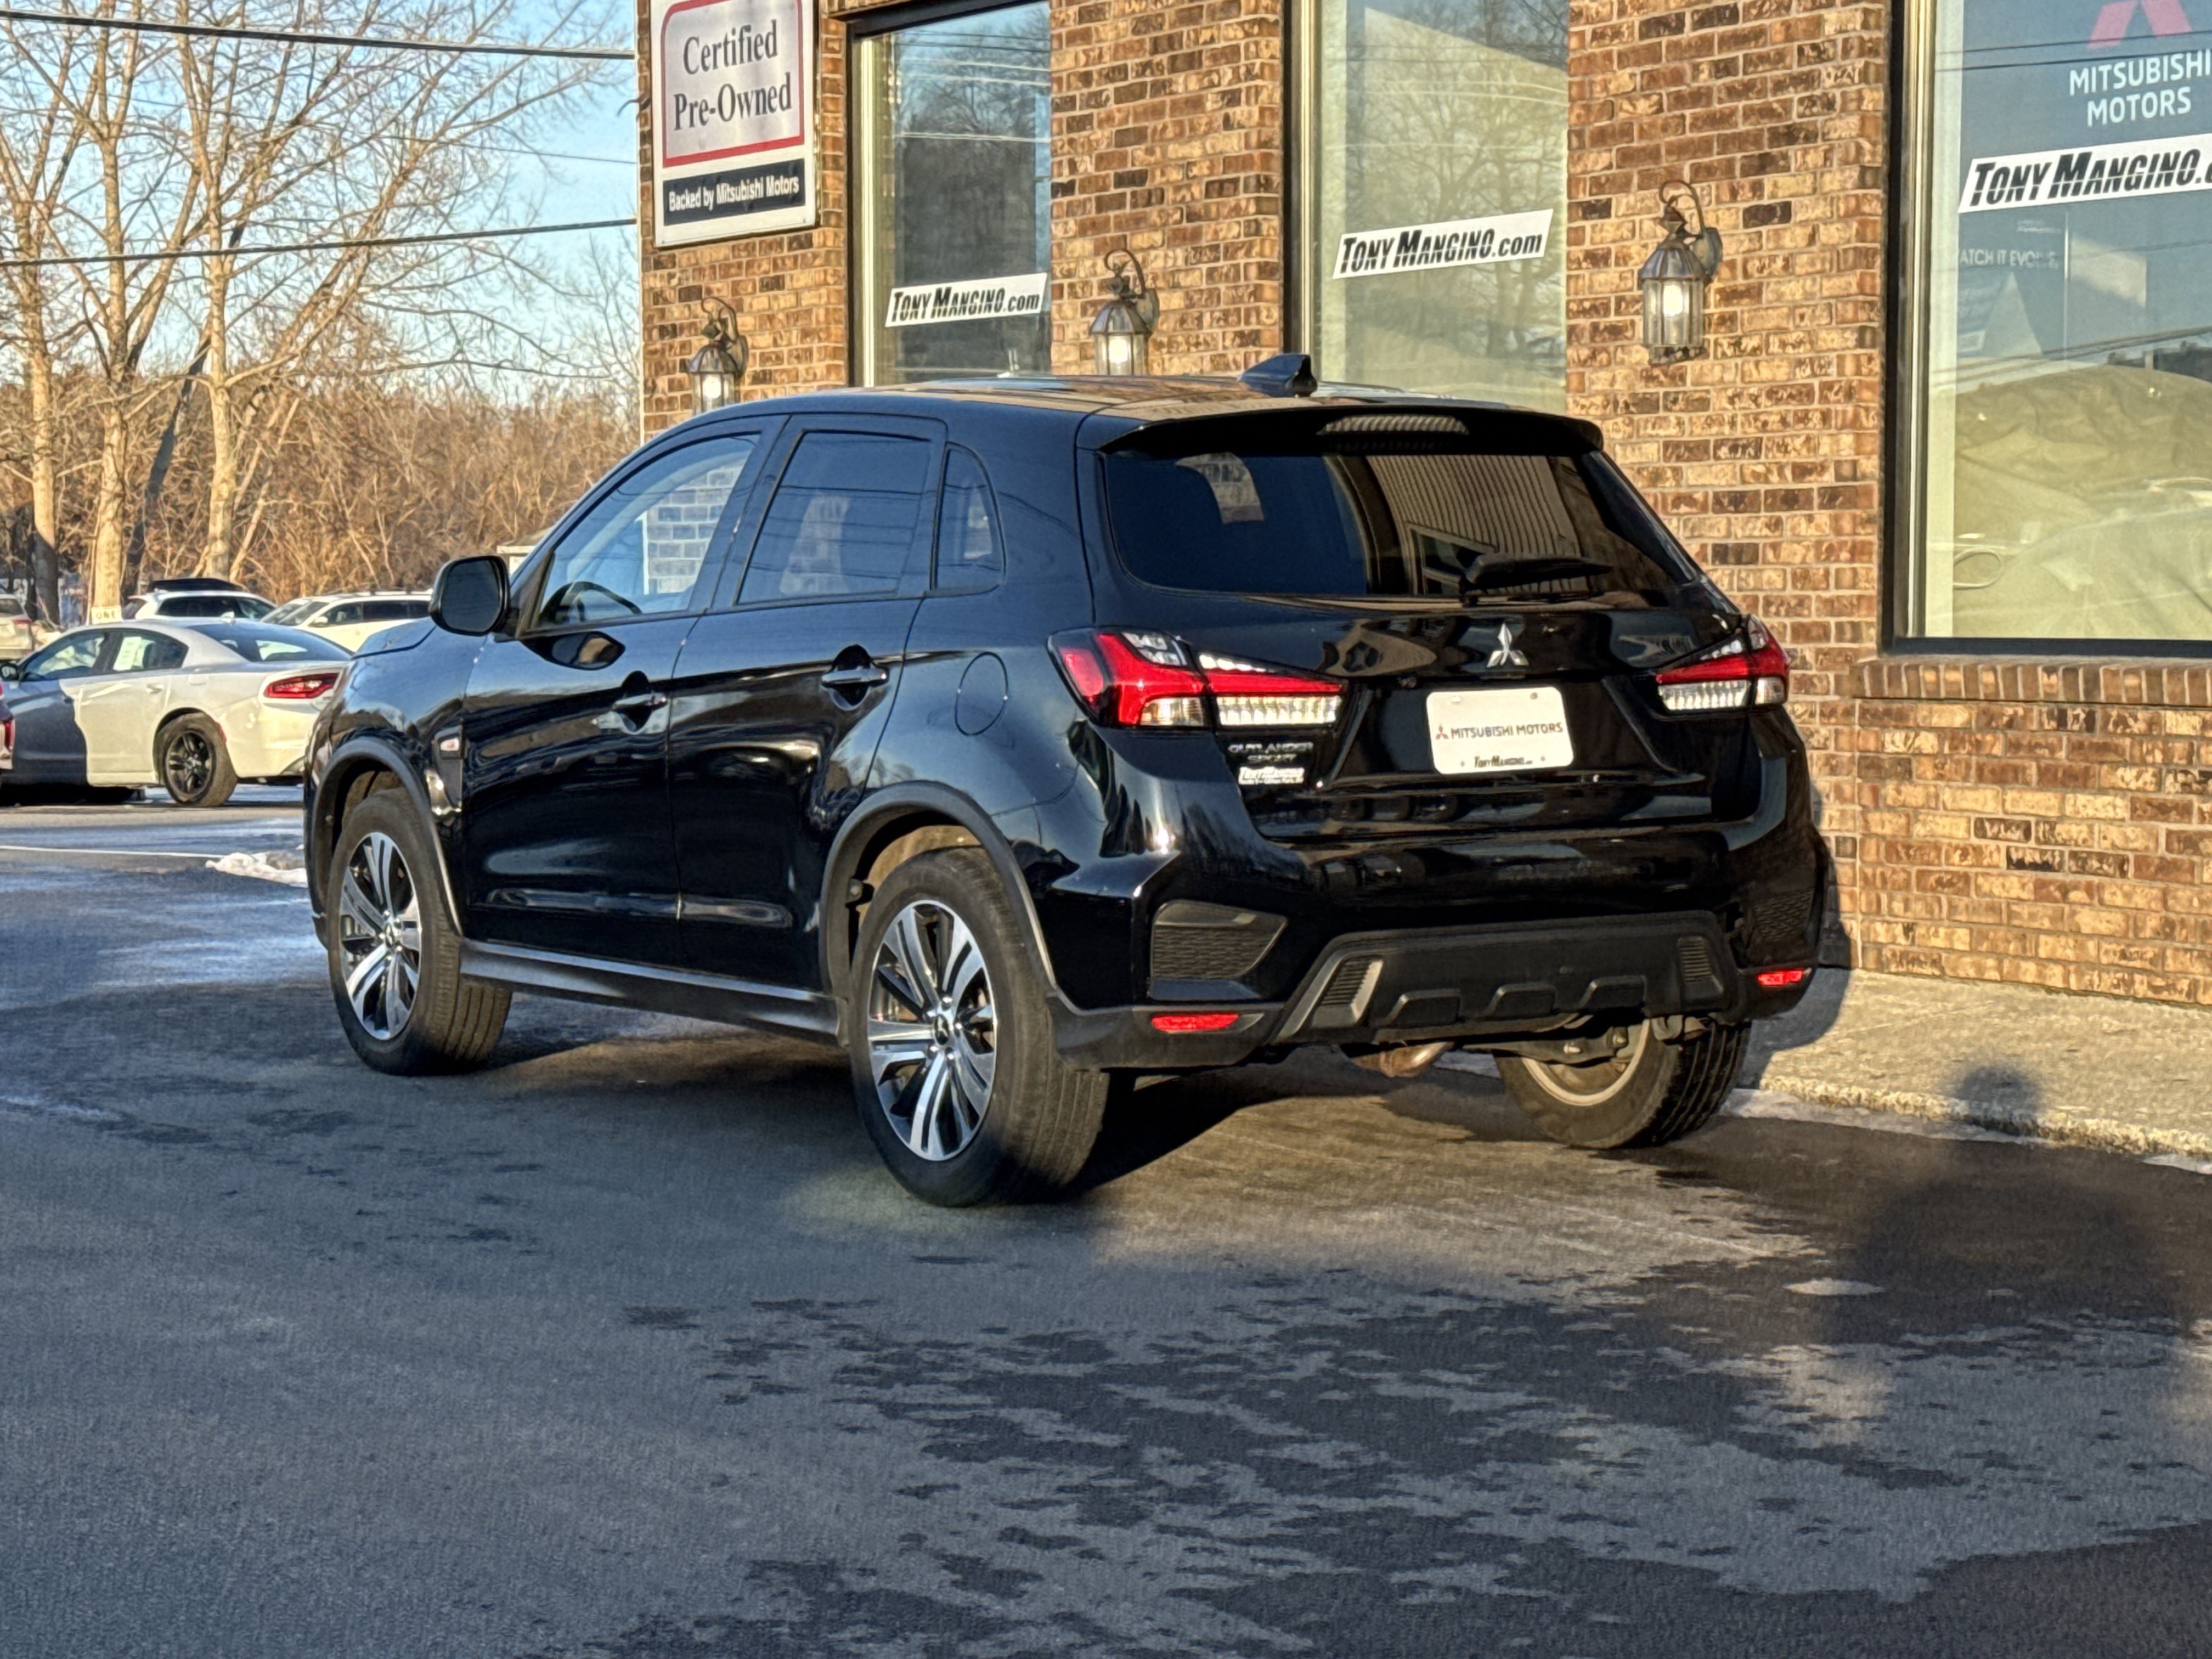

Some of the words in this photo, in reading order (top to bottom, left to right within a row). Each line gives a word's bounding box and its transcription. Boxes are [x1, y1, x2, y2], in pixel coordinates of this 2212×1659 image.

[683, 19, 778, 75] Certified
[2069, 48, 2211, 97] MITSUBISHI
[674, 72, 792, 131] Pre-Owned
[2087, 86, 2191, 128] MOTORS
[669, 186, 702, 212] Backed
[703, 186, 714, 211] by
[716, 176, 764, 205] Mitsubishi
[766, 174, 799, 197] Motors
[1959, 248, 1994, 266] ATCH
[1451, 725, 1514, 739] MITSUBISHI
[1516, 722, 1564, 736] MOTORS
